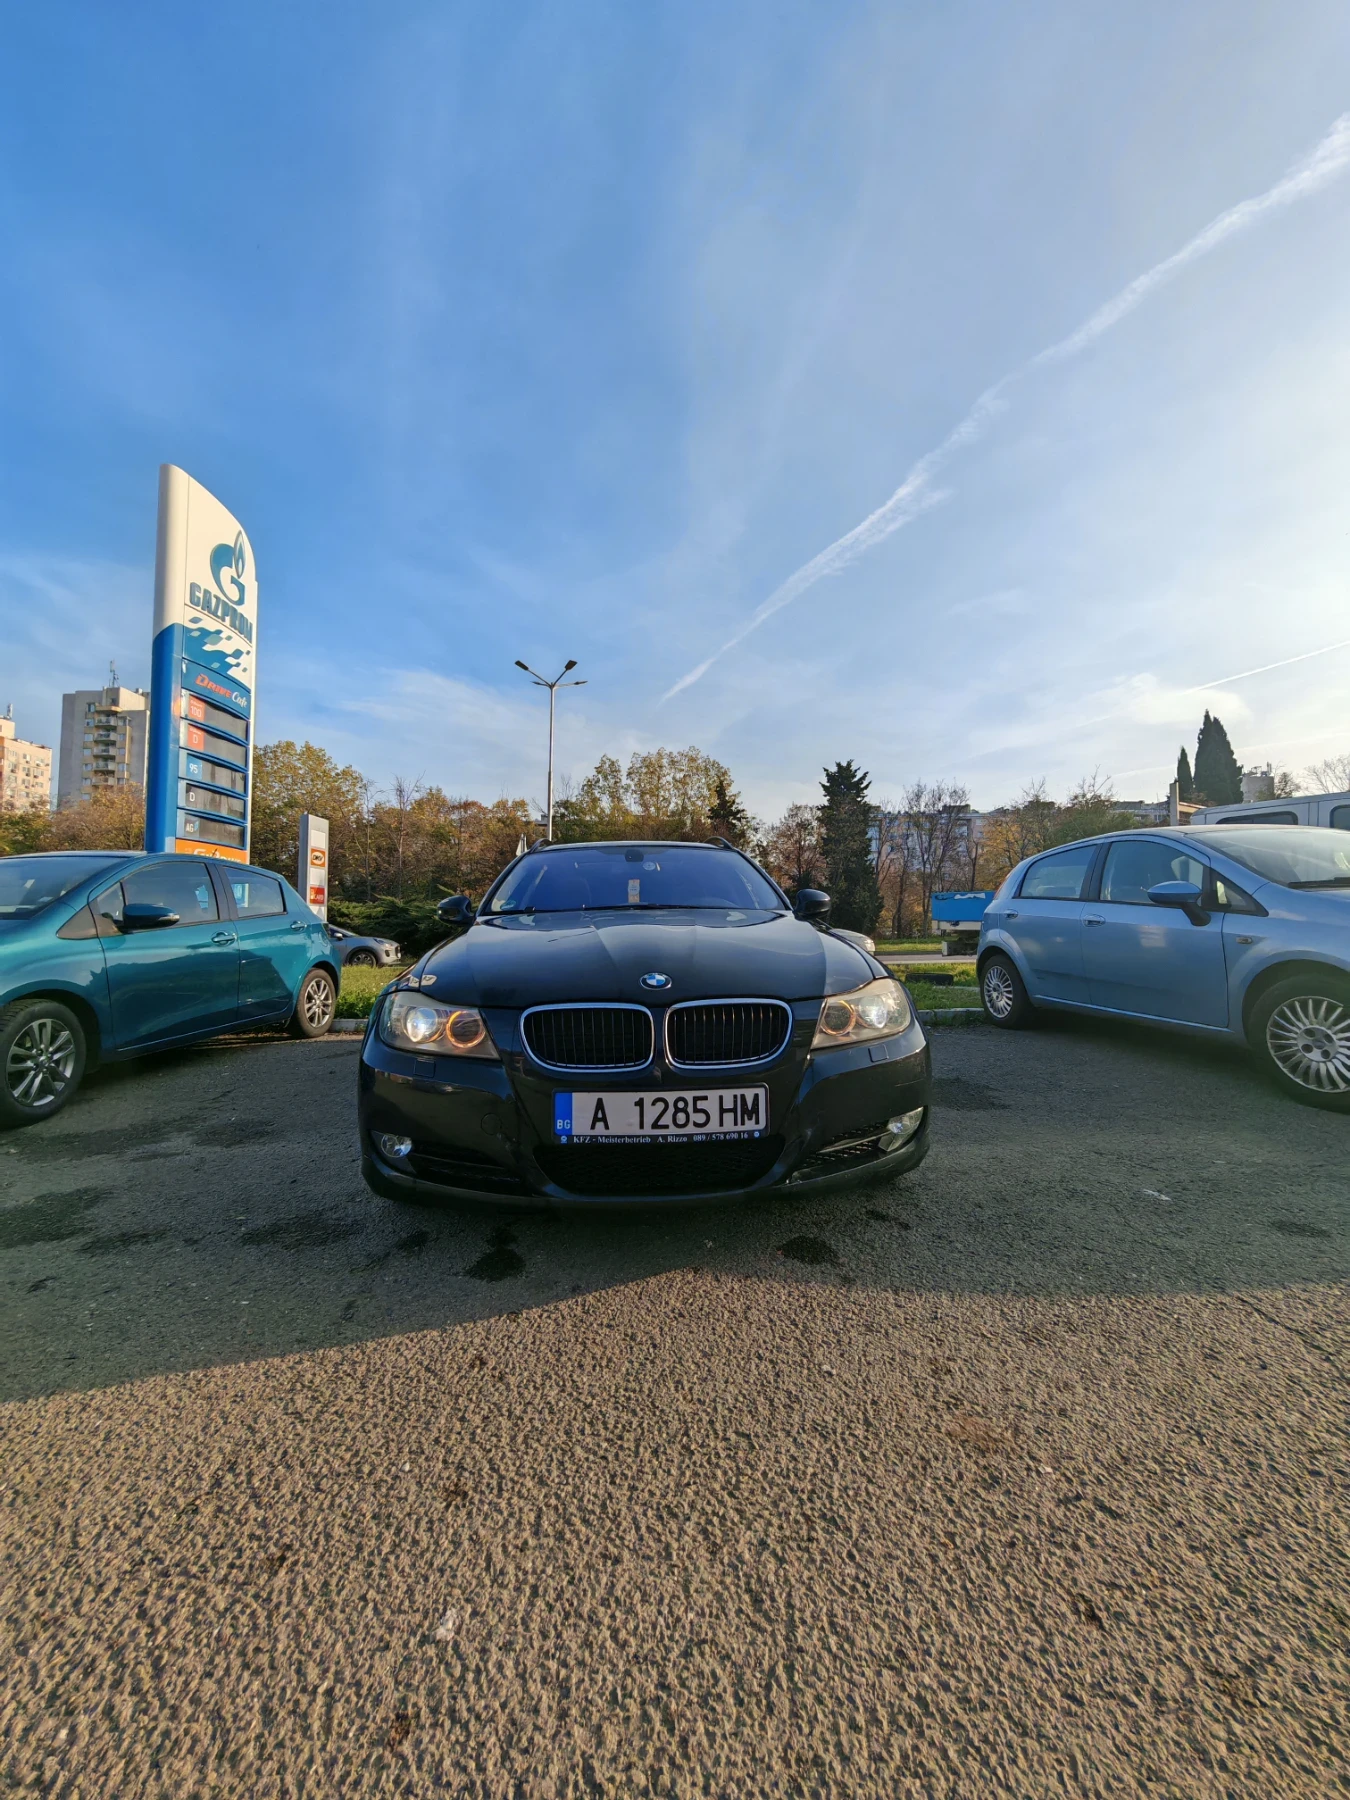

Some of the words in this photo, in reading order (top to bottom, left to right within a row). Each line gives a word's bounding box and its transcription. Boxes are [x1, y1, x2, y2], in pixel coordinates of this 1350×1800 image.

[189, 581, 253, 644] GAZPROM
[195, 673, 232, 698] DRIVE
[190, 705, 202, 718] 100
[192, 734, 199, 744] D
[189, 763, 199, 774] 95
[189, 792, 196, 802] D
[185, 823, 194, 833] AG
[590, 1097, 610, 1130] A
[634, 1095, 711, 1130] 1285
[718, 1093, 760, 1128] HM
[556, 1119, 571, 1130] BG
[573, 1136, 591, 1144] KFZ
[597, 1135, 651, 1144] Meisterbetrieb
[657, 1134, 666, 1143] A.
[667, 1134, 688, 1143] Rizzo
[693, 1133, 706, 1142] 089
[711, 1132, 725, 1141] 578
[725, 1132, 739, 1141] 690
[740, 1131, 749, 1139] 16
